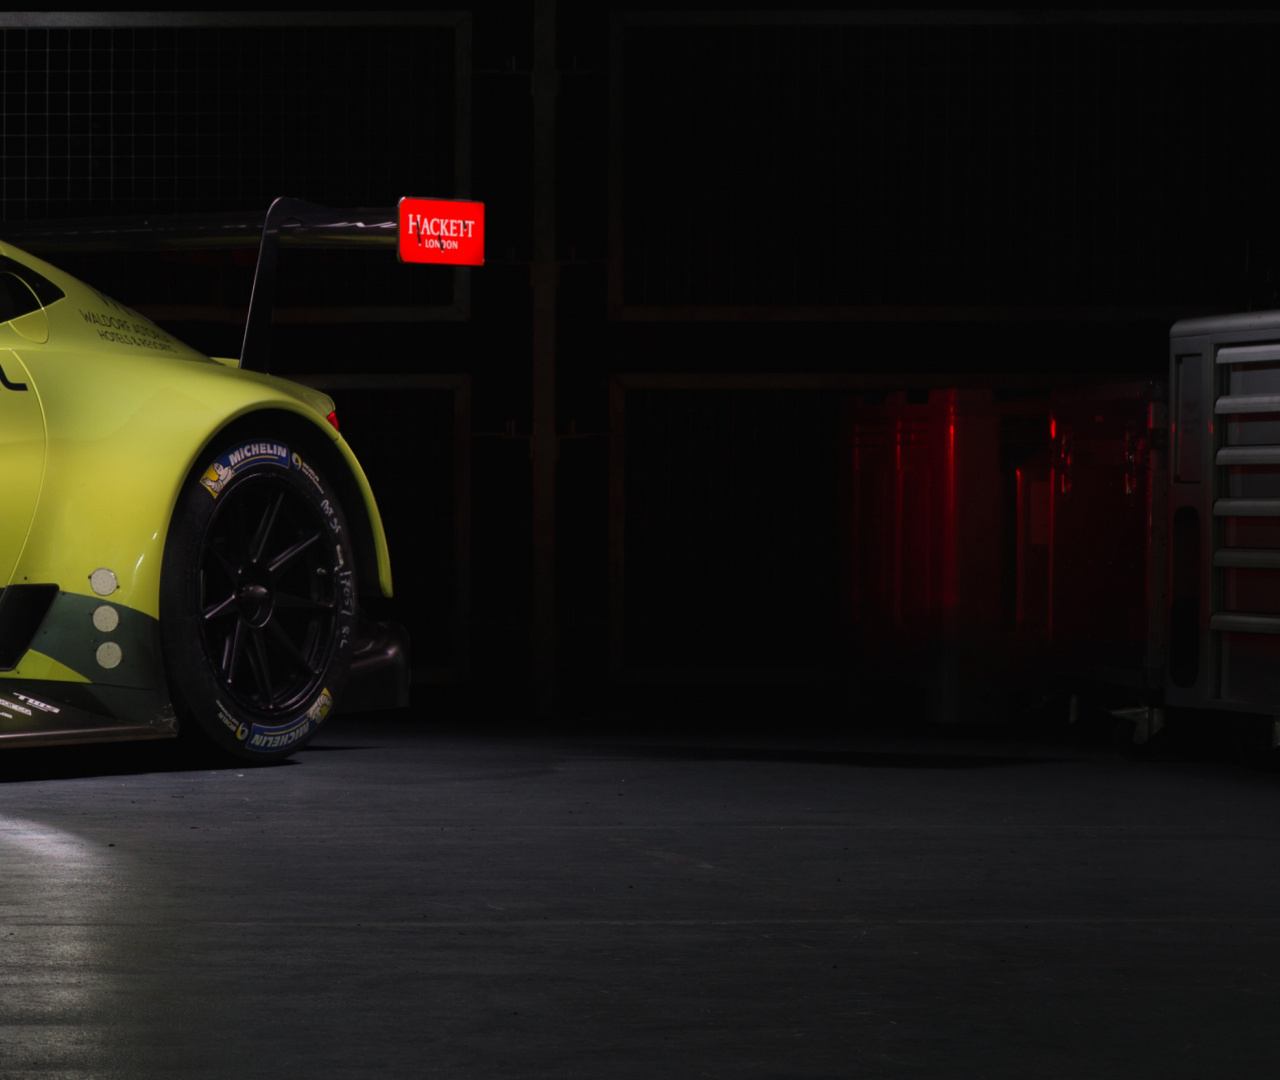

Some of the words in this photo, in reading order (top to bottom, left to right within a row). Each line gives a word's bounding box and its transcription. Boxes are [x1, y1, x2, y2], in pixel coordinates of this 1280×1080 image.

[408, 214, 475, 238] HACKETT
[228, 442, 287, 467] MICHELIN
[250, 721, 309, 748] MICHELIN
